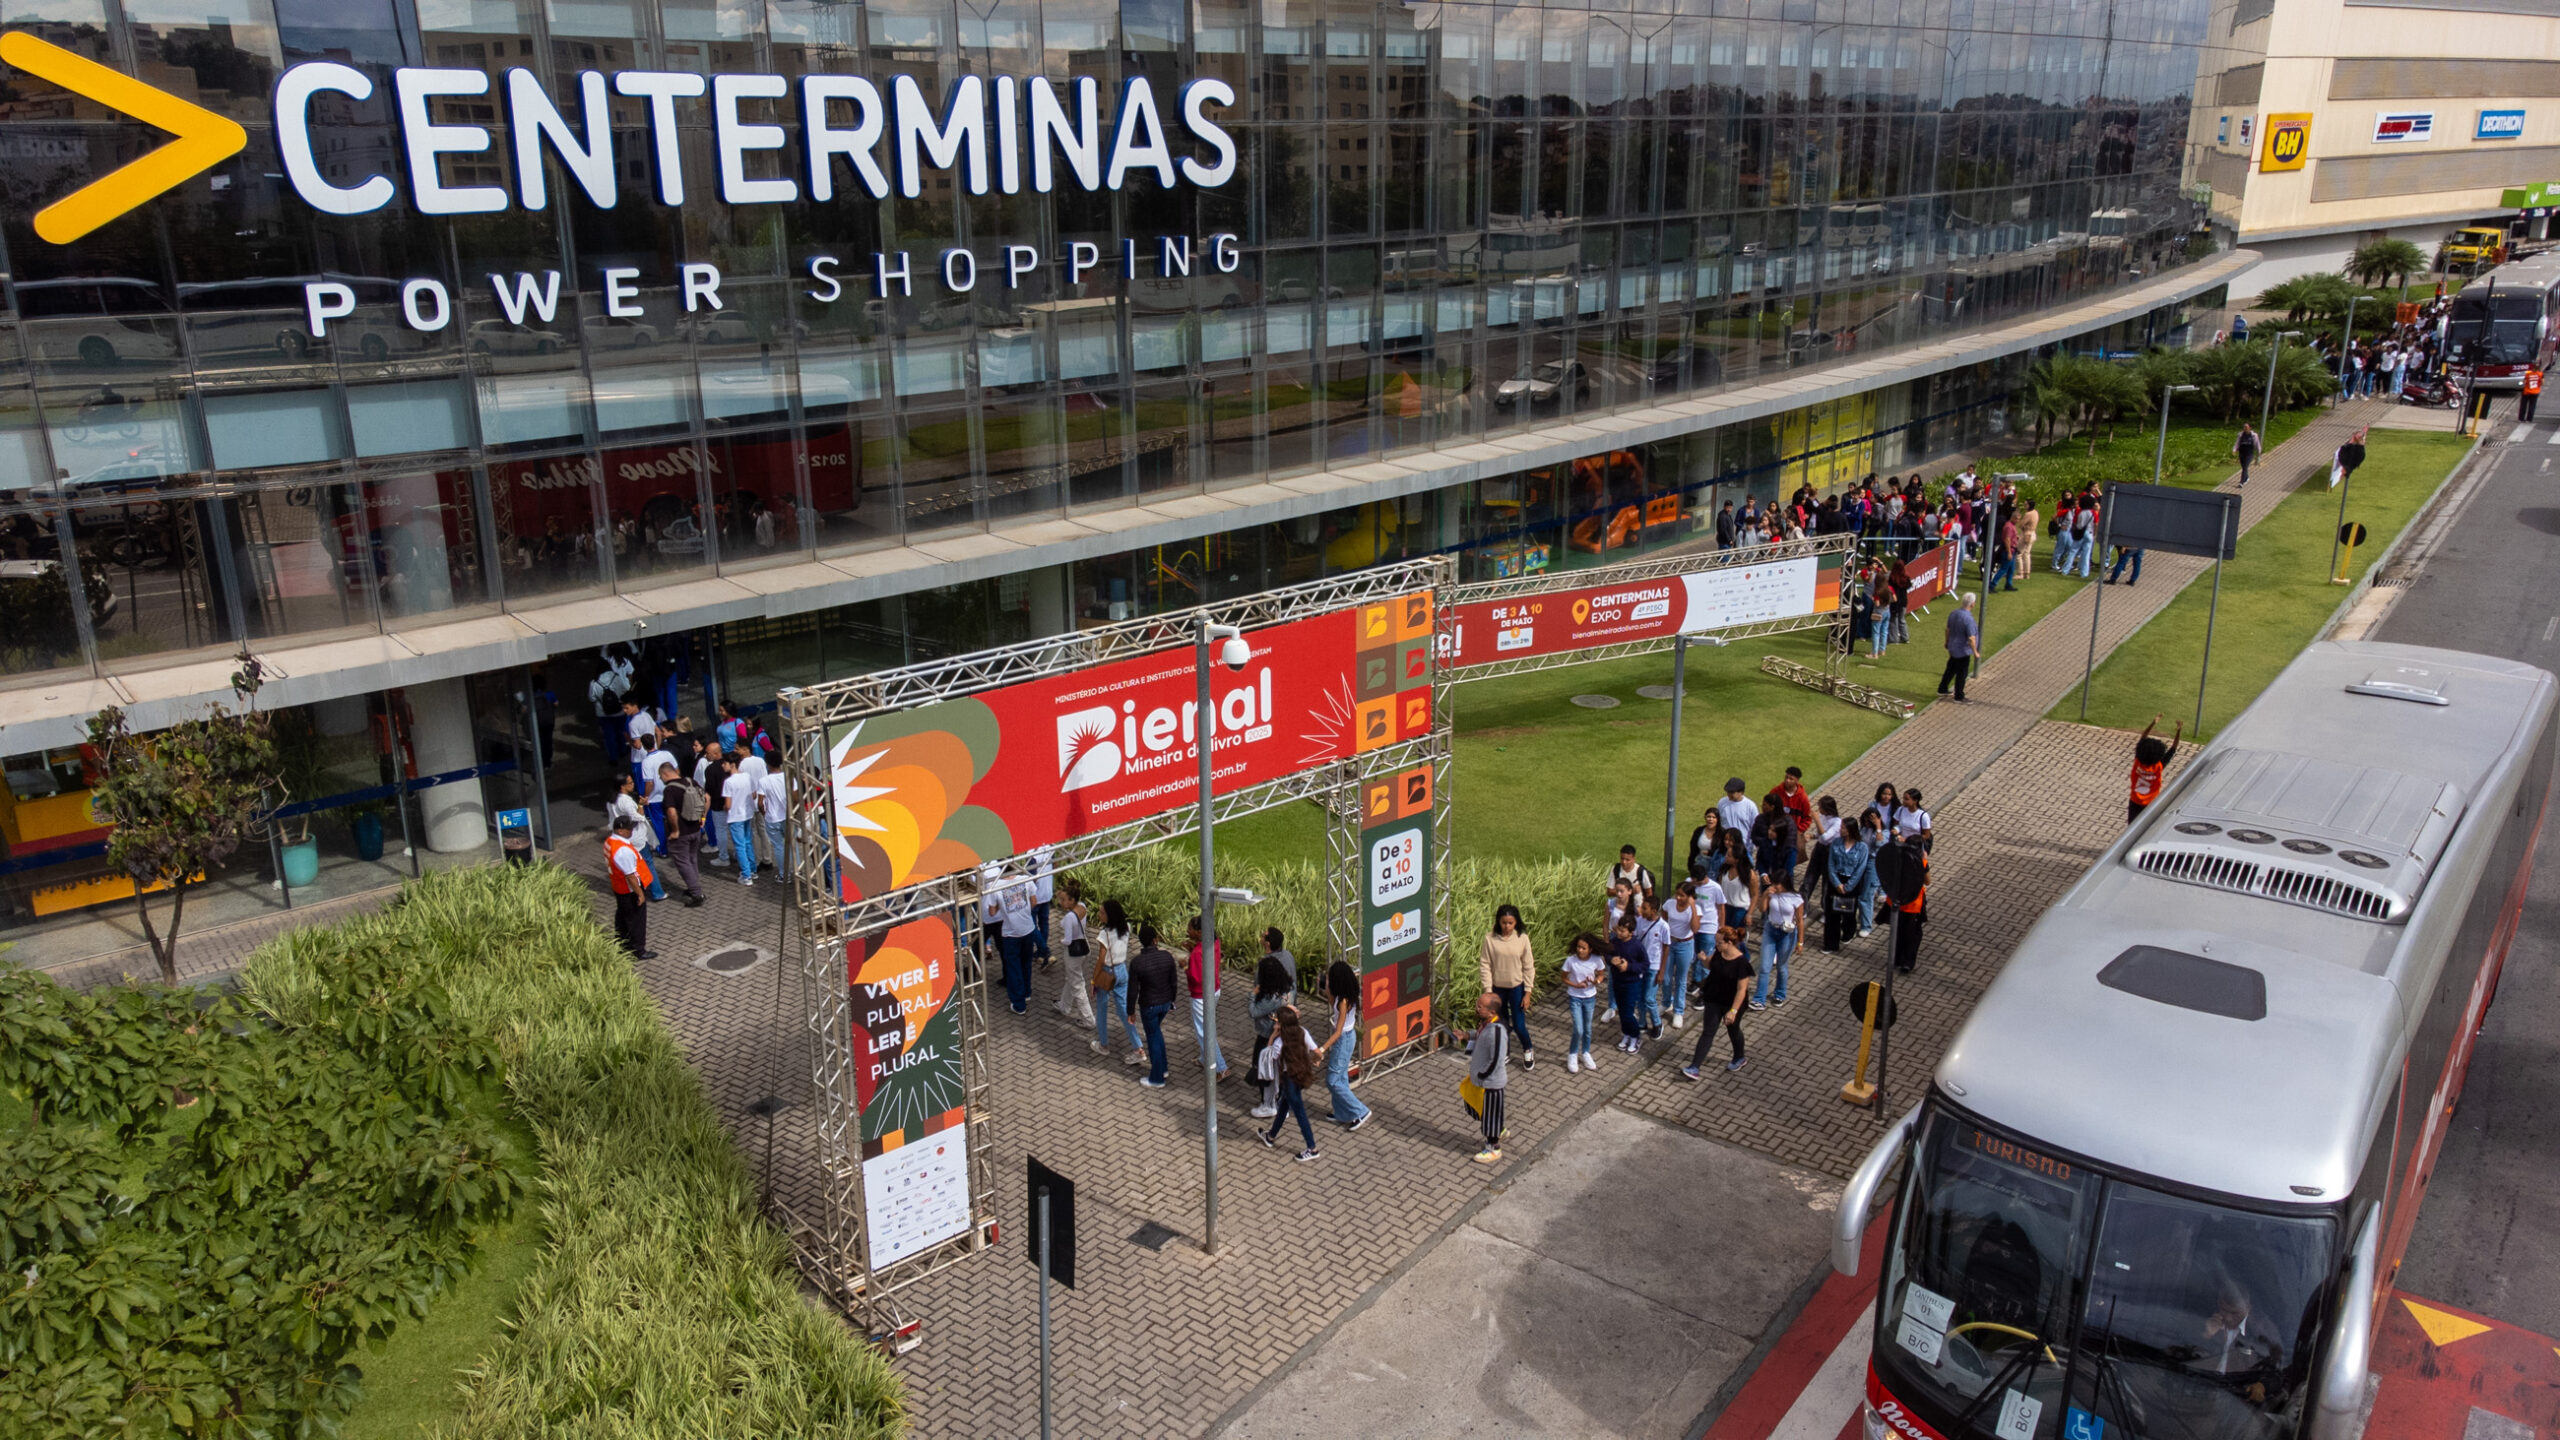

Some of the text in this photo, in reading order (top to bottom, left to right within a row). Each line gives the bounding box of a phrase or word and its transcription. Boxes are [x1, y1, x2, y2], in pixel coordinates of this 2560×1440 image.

[2481, 115, 2524, 132] DECATHLON
[273, 62, 1237, 215] CENTERMINAS
[2275, 130, 2302, 156] BH
[304, 233, 1240, 338] POWER SHOPPING
[1592, 587, 1670, 608] CENTERMINAS
[1492, 603, 1543, 620] DE 3 A 10
[1501, 616, 1533, 628] DE MAIO
[1591, 609, 1622, 624] EXPO
[1572, 620, 1663, 640] bienalmineiradolivro.com.br
[1055, 688, 1097, 704] MINISTÉRIO
[1098, 686, 1108, 695] DA
[1109, 678, 1140, 691] CULTURA
[1140, 676, 1146, 684] E
[1146, 668, 1183, 683] INSTITUTO
[1183, 660, 1216, 674] CULAL
[1056, 667, 1272, 794] Bienal
[1125, 749, 1183, 776] Mineira
[1210, 734, 1242, 753] livro
[1247, 726, 1269, 741] 2025
[1092, 762, 1247, 814] bienalmineiradolivrcom.br
[1380, 838, 1413, 862] De 3
[1382, 858, 1411, 880] a 10
[1378, 875, 1414, 896] DE MAIO
[1376, 933, 1392, 948] 08h
[1403, 926, 1417, 938] 21h
[864, 959, 940, 1000] VIVER É
[866, 992, 941, 1028] PLURAL.
[868, 1021, 917, 1055] LER É
[871, 1045, 940, 1081] PLURAL
[1973, 1130, 2071, 1180] TURISMO
[1920, 1304, 1932, 1316] 01
[1907, 1334, 1930, 1354] B/C
[2015, 1406, 2032, 1433] B/C
